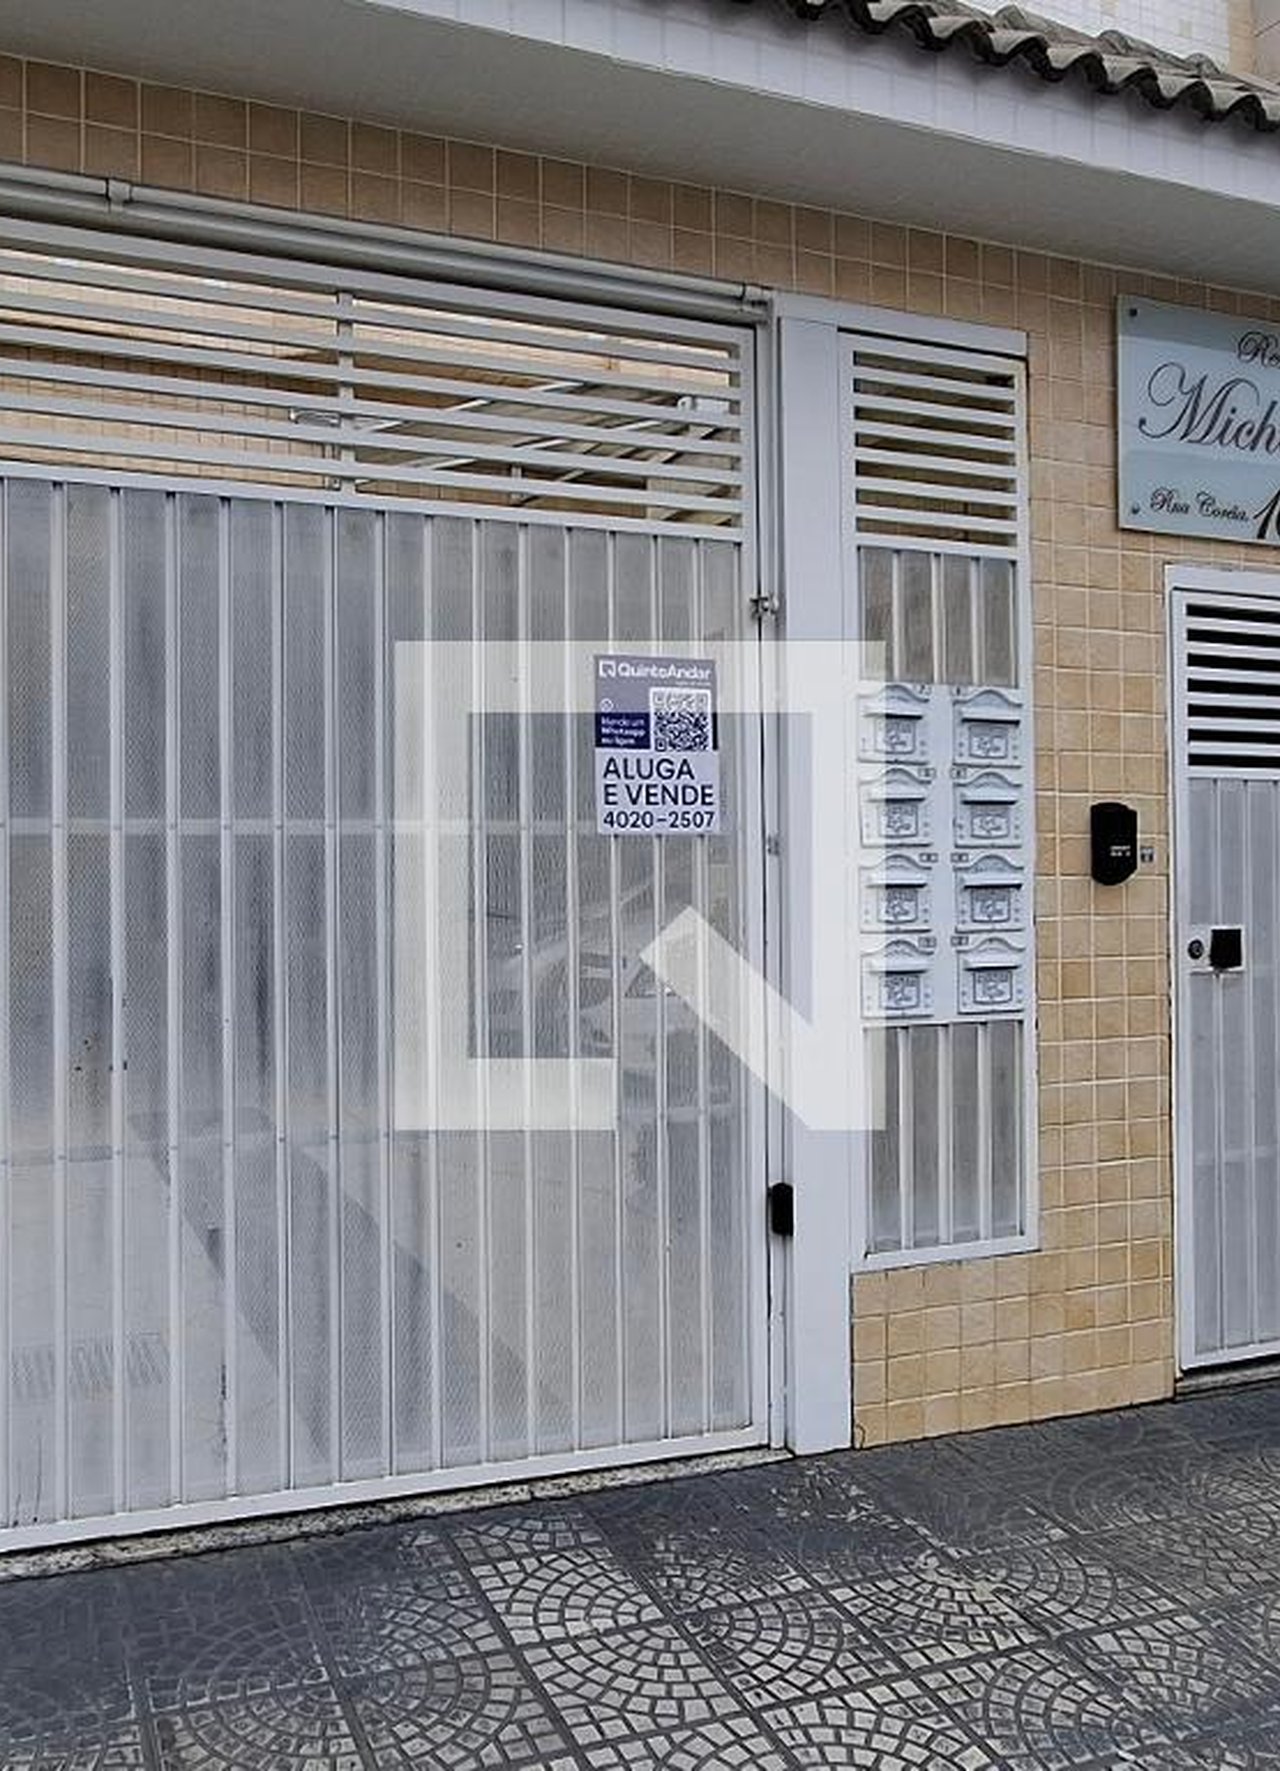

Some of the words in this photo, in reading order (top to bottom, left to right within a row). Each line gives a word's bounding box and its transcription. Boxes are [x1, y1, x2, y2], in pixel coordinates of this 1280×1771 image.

[1150, 486, 1190, 515] Rua
[618, 662, 712, 680] QuintoAndar
[603, 757, 695, 780] ALUGA
[604, 784, 618, 806] E
[625, 784, 715, 806] VENDE
[603, 811, 715, 828] 4020-2507
